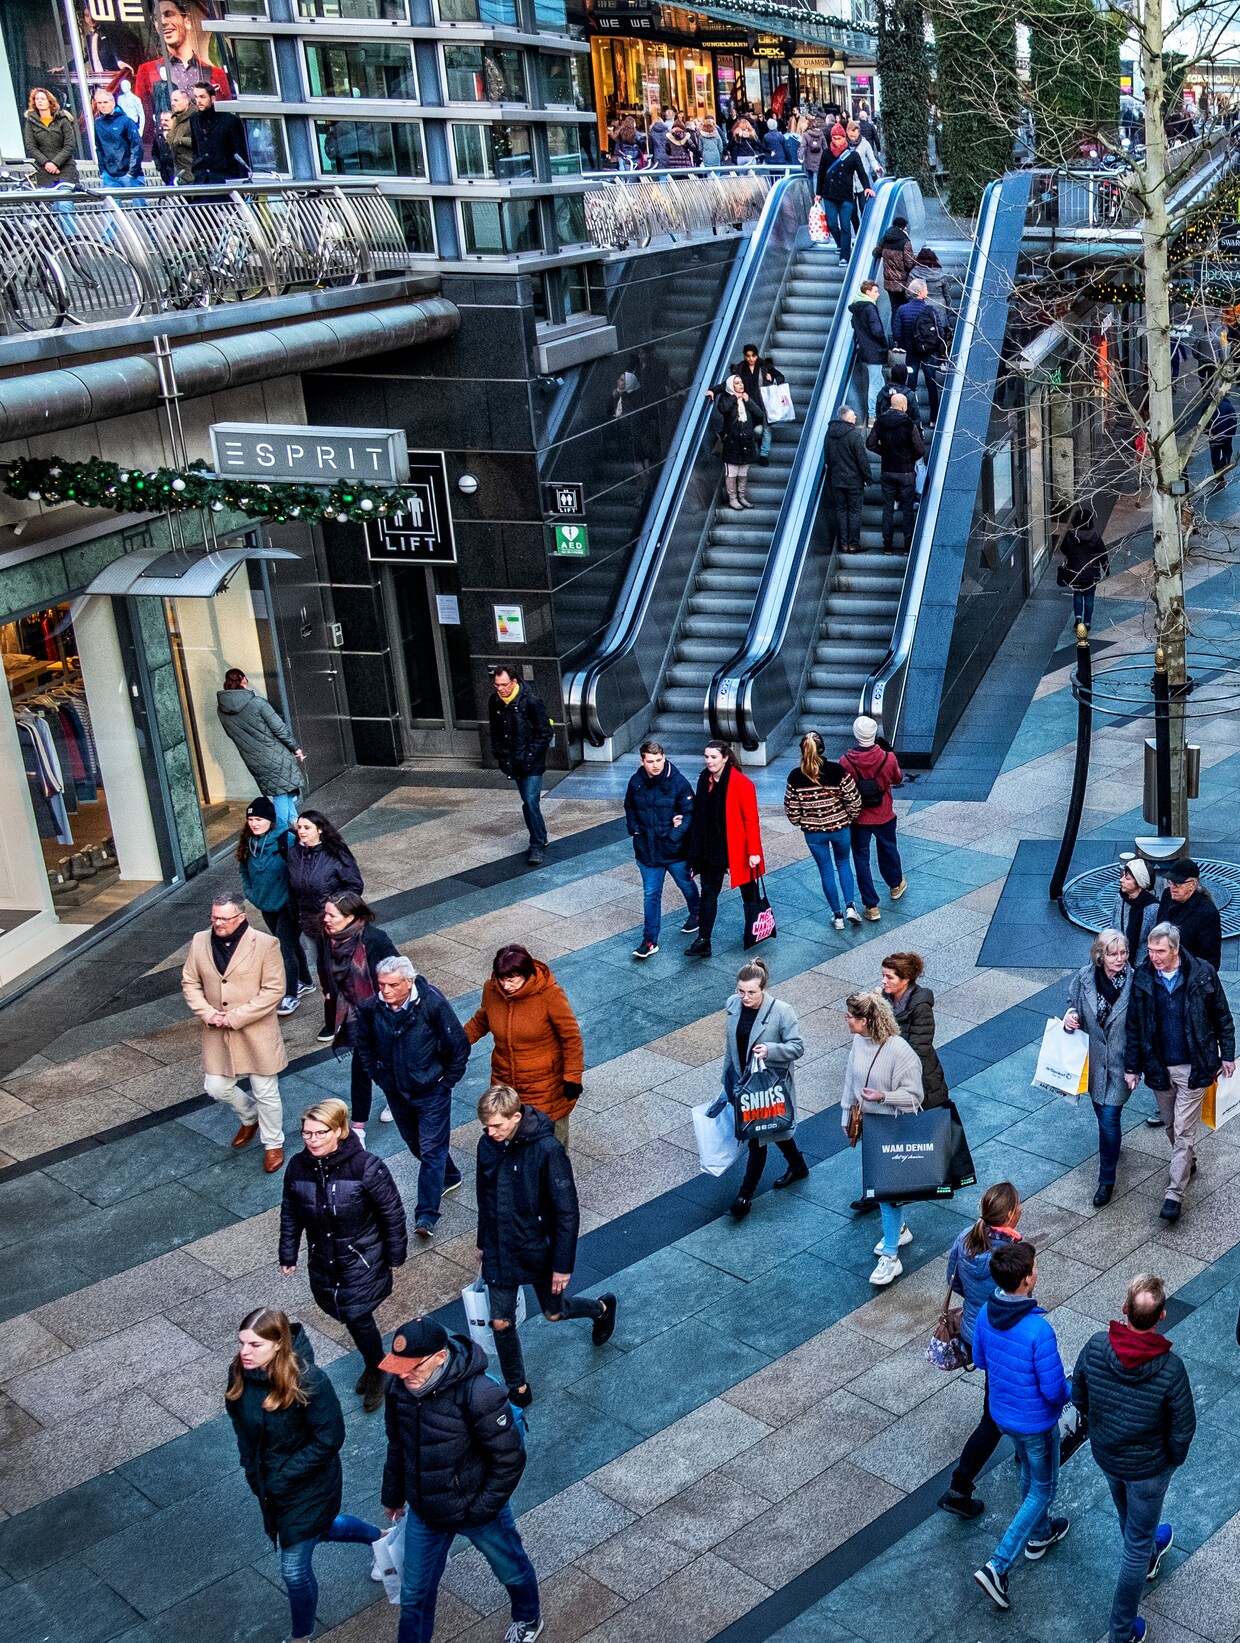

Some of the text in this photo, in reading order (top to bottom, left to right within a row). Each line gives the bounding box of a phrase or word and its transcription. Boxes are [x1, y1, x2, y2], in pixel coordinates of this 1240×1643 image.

[88, 0, 145, 22] WE
[600, 19, 620, 28] WE
[630, 19, 651, 28] WE
[225, 441, 383, 471] ESPRIT
[385, 536, 436, 552] LIFT
[561, 541, 583, 549] AED
[882, 1143, 934, 1153] WAM DENIM
